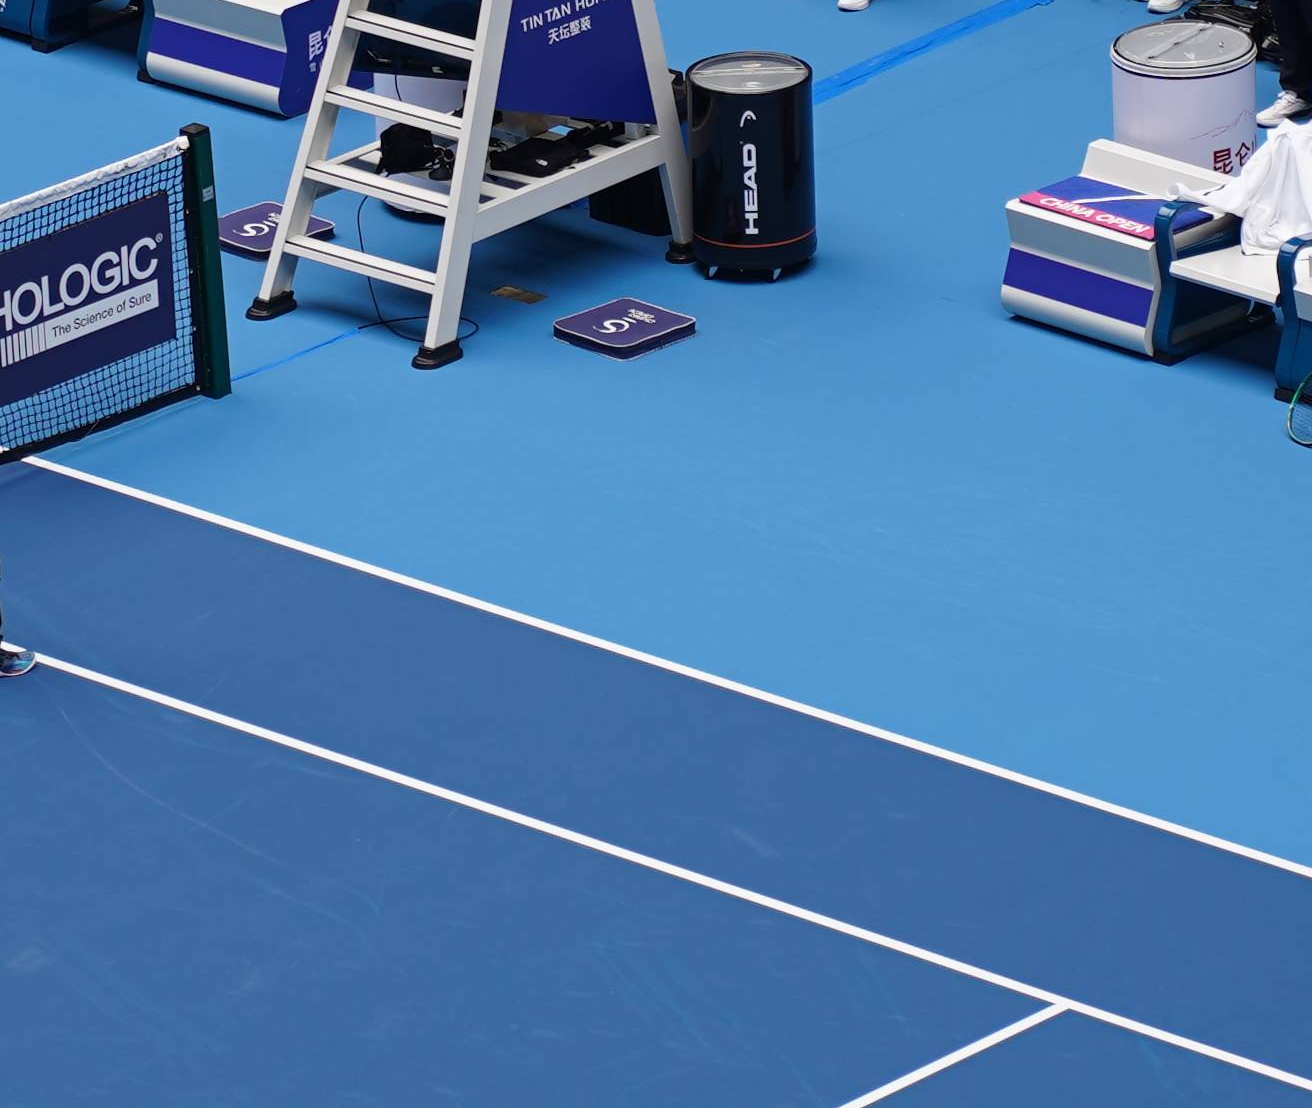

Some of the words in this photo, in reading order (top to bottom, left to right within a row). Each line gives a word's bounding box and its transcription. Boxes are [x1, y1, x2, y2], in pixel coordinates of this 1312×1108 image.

[520, 13, 543, 32] TIN
[544, 1, 571, 23] TAN
[742, 143, 759, 235] HEAD
[1039, 197, 1096, 218] CHINA
[1095, 213, 1152, 233] OPEN
[52, 325, 72, 338] The
[72, 307, 115, 330] Science
[116, 300, 127, 314] of
[128, 293, 152, 309] Sure
